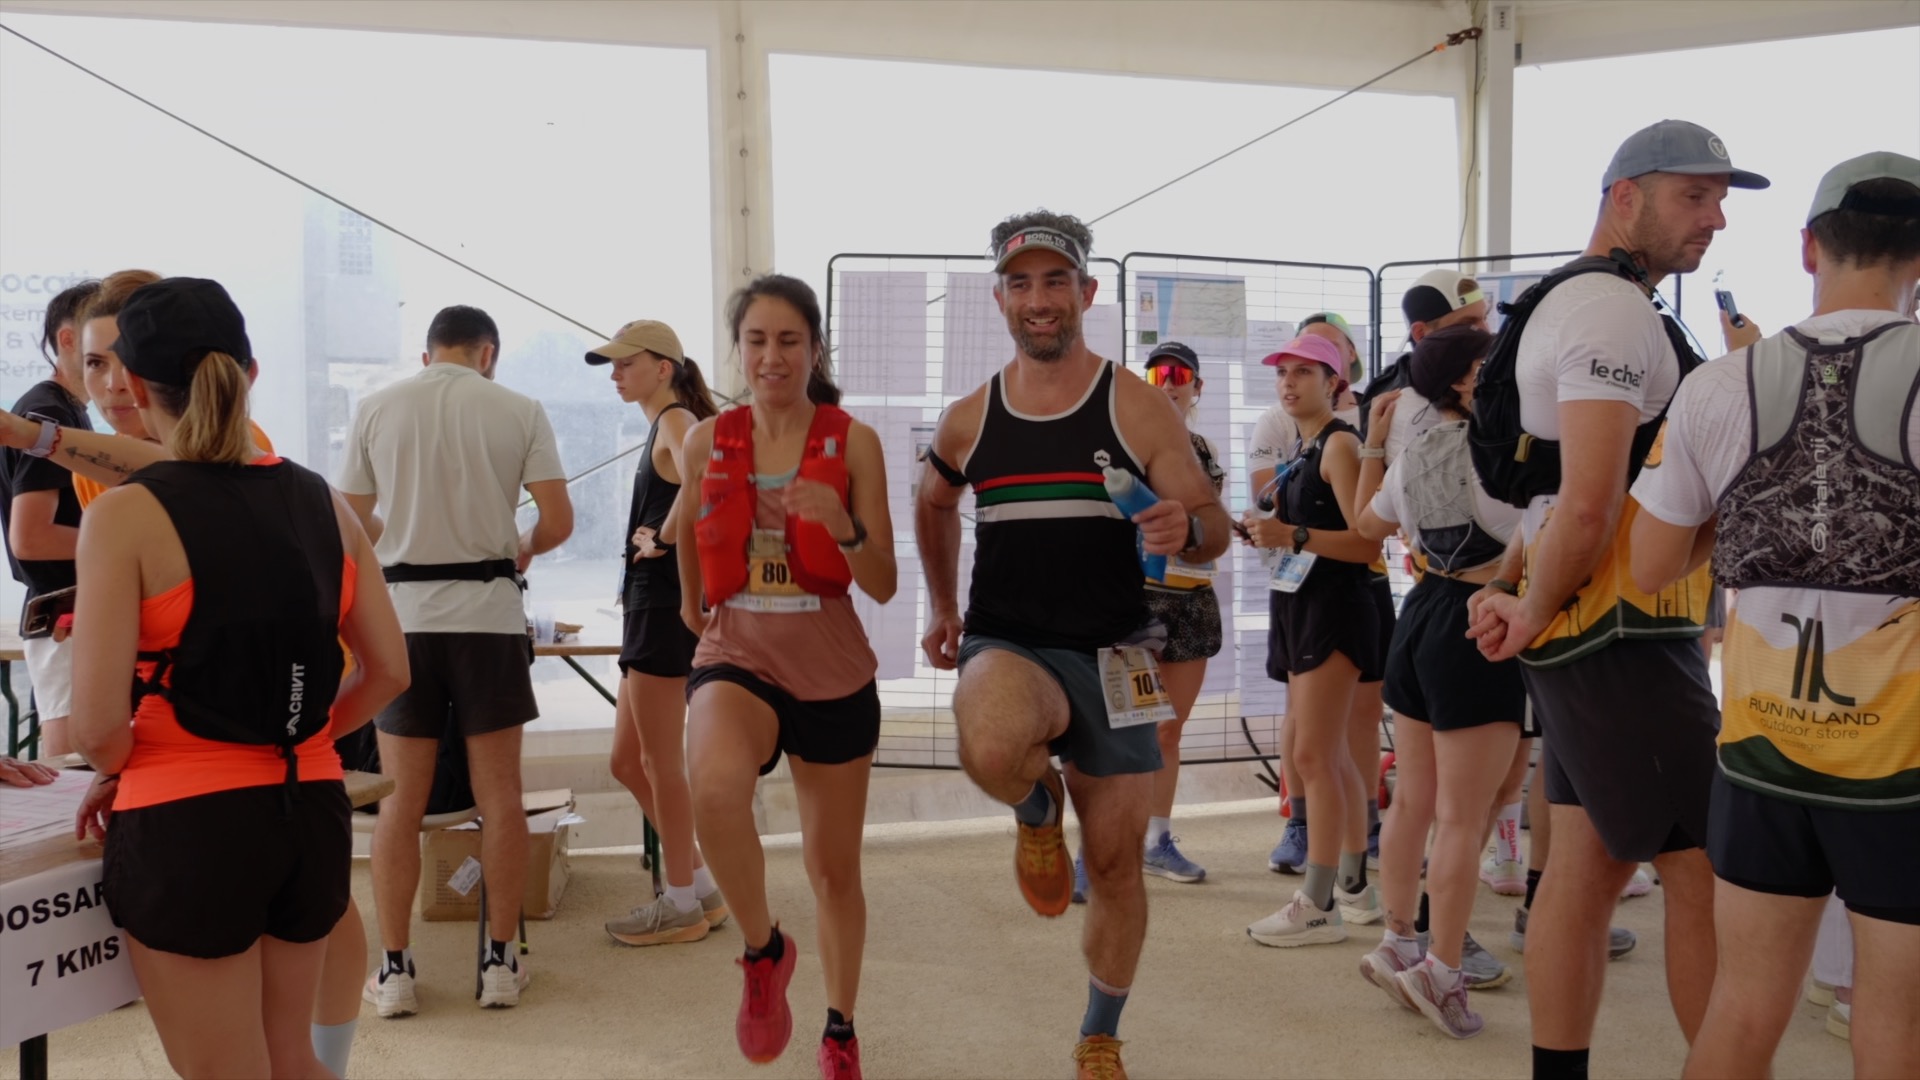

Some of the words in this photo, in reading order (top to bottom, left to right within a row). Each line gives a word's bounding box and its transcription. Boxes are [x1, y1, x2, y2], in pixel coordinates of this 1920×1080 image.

[1590, 358, 1609, 379] le
[1810, 437, 1831, 517] kalenji
[761, 562, 799, 585] 80
[288, 662, 305, 714] CRIVIT
[1749, 697, 1783, 717] RUN
[1786, 706, 1806, 722] IN
[1811, 711, 1881, 726] LAND
[1759, 717, 1810, 737] outdoor
[1816, 728, 1860, 740] store
[26, 959, 45, 988] 7
[56, 935, 120, 979] KMS
